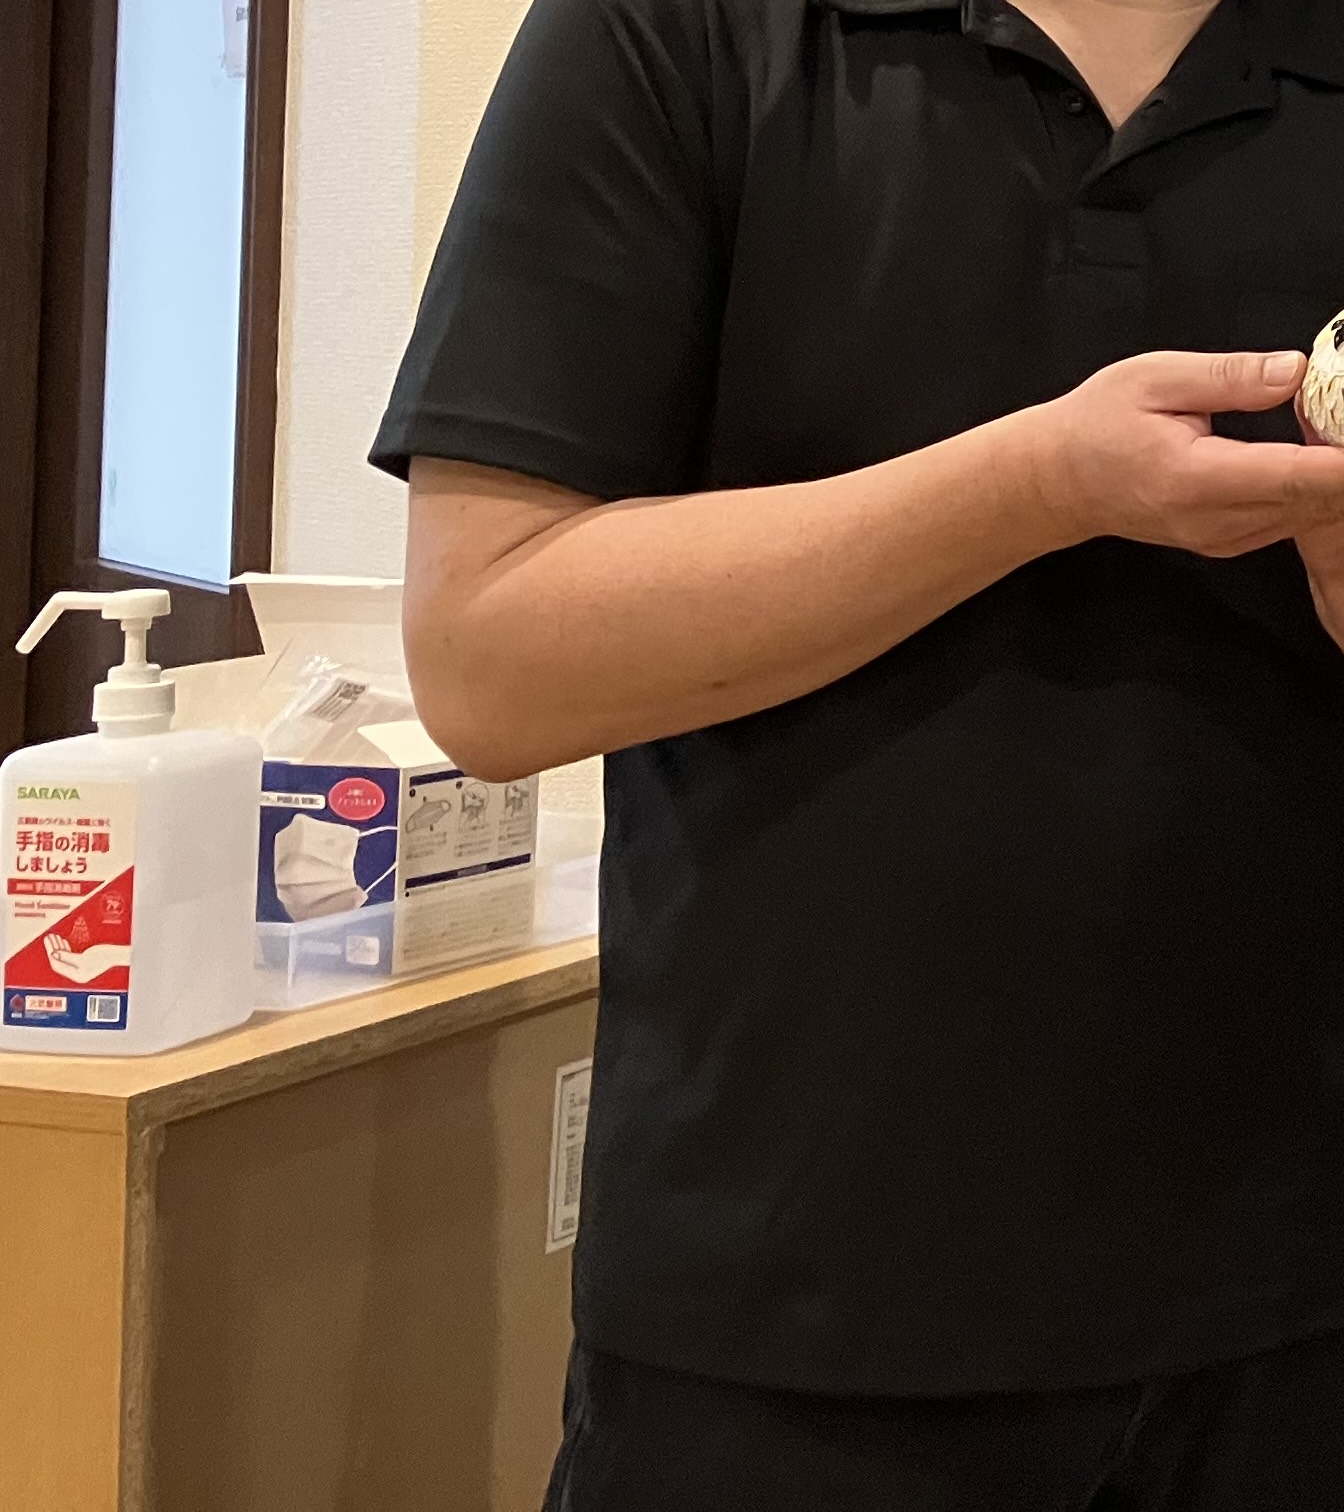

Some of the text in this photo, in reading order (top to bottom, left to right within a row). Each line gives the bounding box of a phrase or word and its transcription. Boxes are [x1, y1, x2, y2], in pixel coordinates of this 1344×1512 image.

[17, 786, 81, 800] SARAYA
[16, 830, 110, 854] 手指の消毒
[16, 855, 88, 874] しましょう
